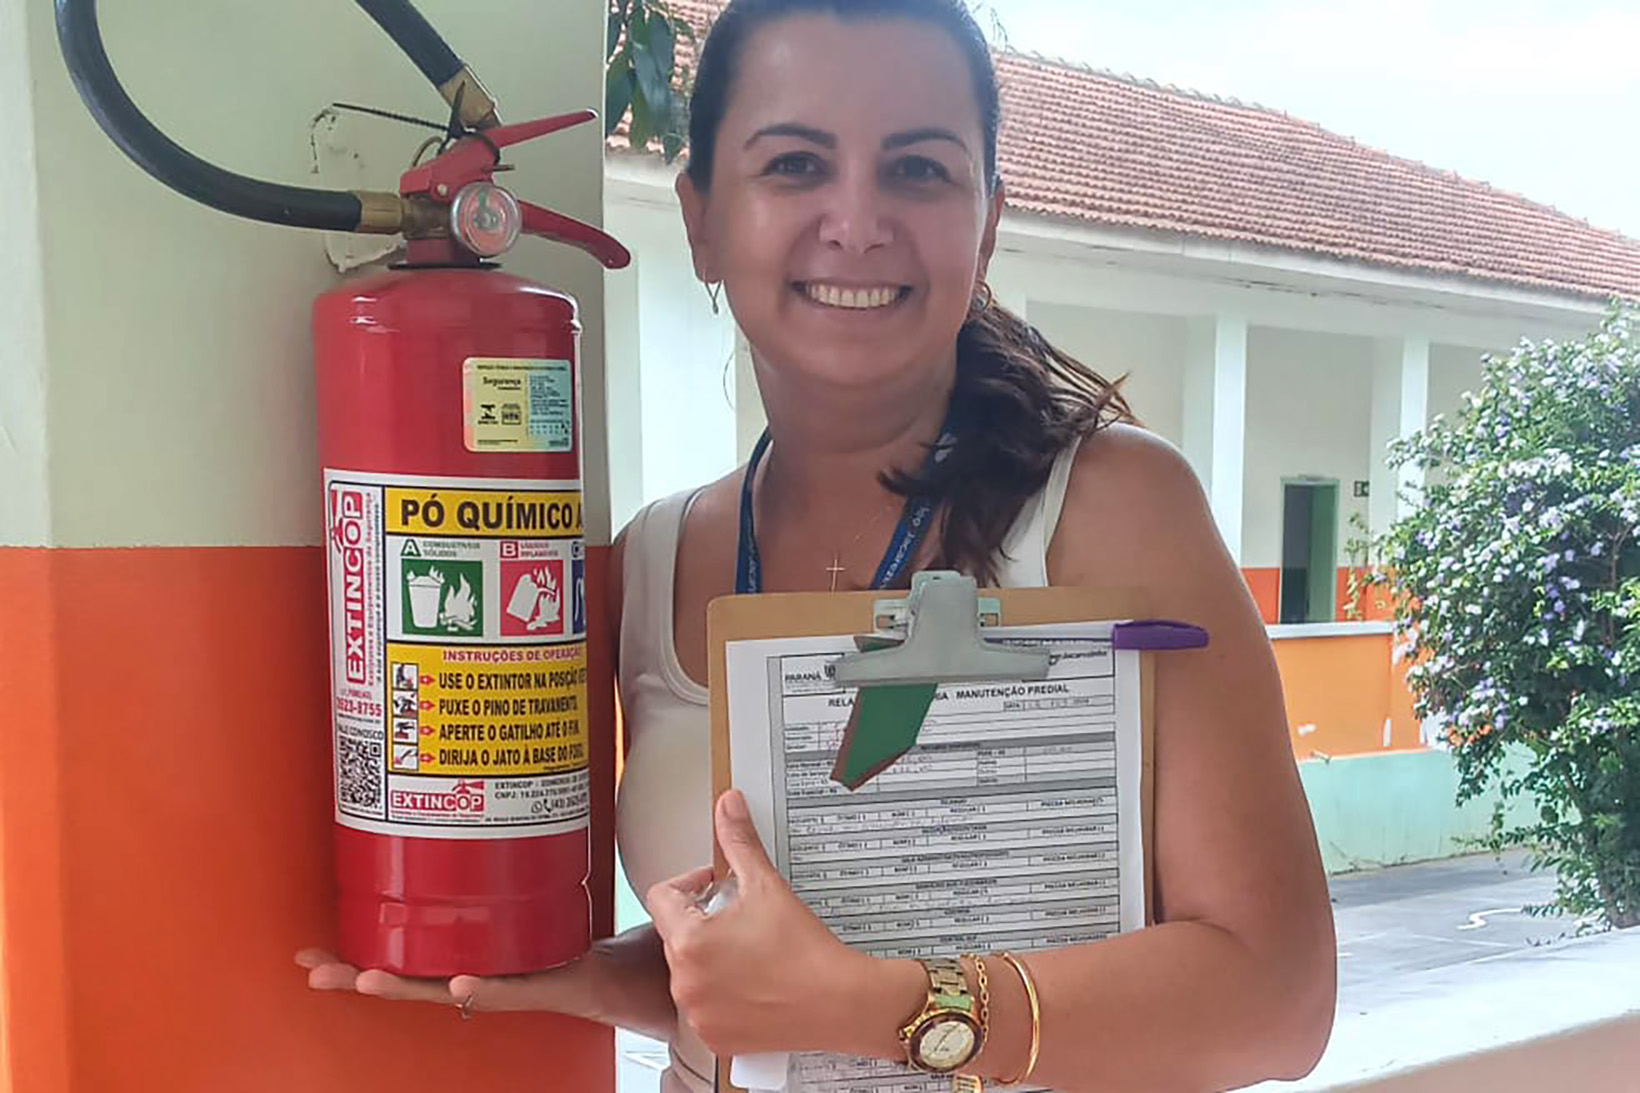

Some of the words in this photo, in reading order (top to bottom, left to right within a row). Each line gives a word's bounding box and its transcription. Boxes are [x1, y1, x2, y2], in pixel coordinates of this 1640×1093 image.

[401, 493, 445, 527] PÓ
[456, 494, 573, 531] QUÍMICO
[402, 539, 421, 557] A
[502, 543, 517, 557] B
[341, 491, 366, 684] EXTINCOP
[443, 648, 524, 663] INSTRUÇÕES
[526, 651, 541, 661] DE
[439, 672, 463, 690] USE
[466, 672, 474, 689] O
[477, 673, 531, 691] EXTINTOR
[534, 672, 547, 689] NA
[785, 671, 822, 681] PARANÁ
[828, 697, 854, 707] RELA
[956, 686, 1026, 700] MANUTENÇÃO
[1028, 684, 1070, 696] PREDIAL
[439, 698, 469, 716] PUXE
[472, 699, 480, 716] O
[483, 698, 510, 716] PINO
[513, 699, 526, 716] DE
[439, 723, 484, 742] APERTE
[488, 724, 496, 741] O
[499, 724, 544, 741] GATILHO
[545, 717, 560, 738] ATÉ
[439, 747, 478, 766] DIRIJA
[481, 749, 489, 766] O
[492, 749, 520, 765] JATO
[523, 744, 530, 765] À
[532, 746, 556, 764] BASE
[557, 745, 568, 761] DO
[391, 789, 484, 812] EXTINCOP
